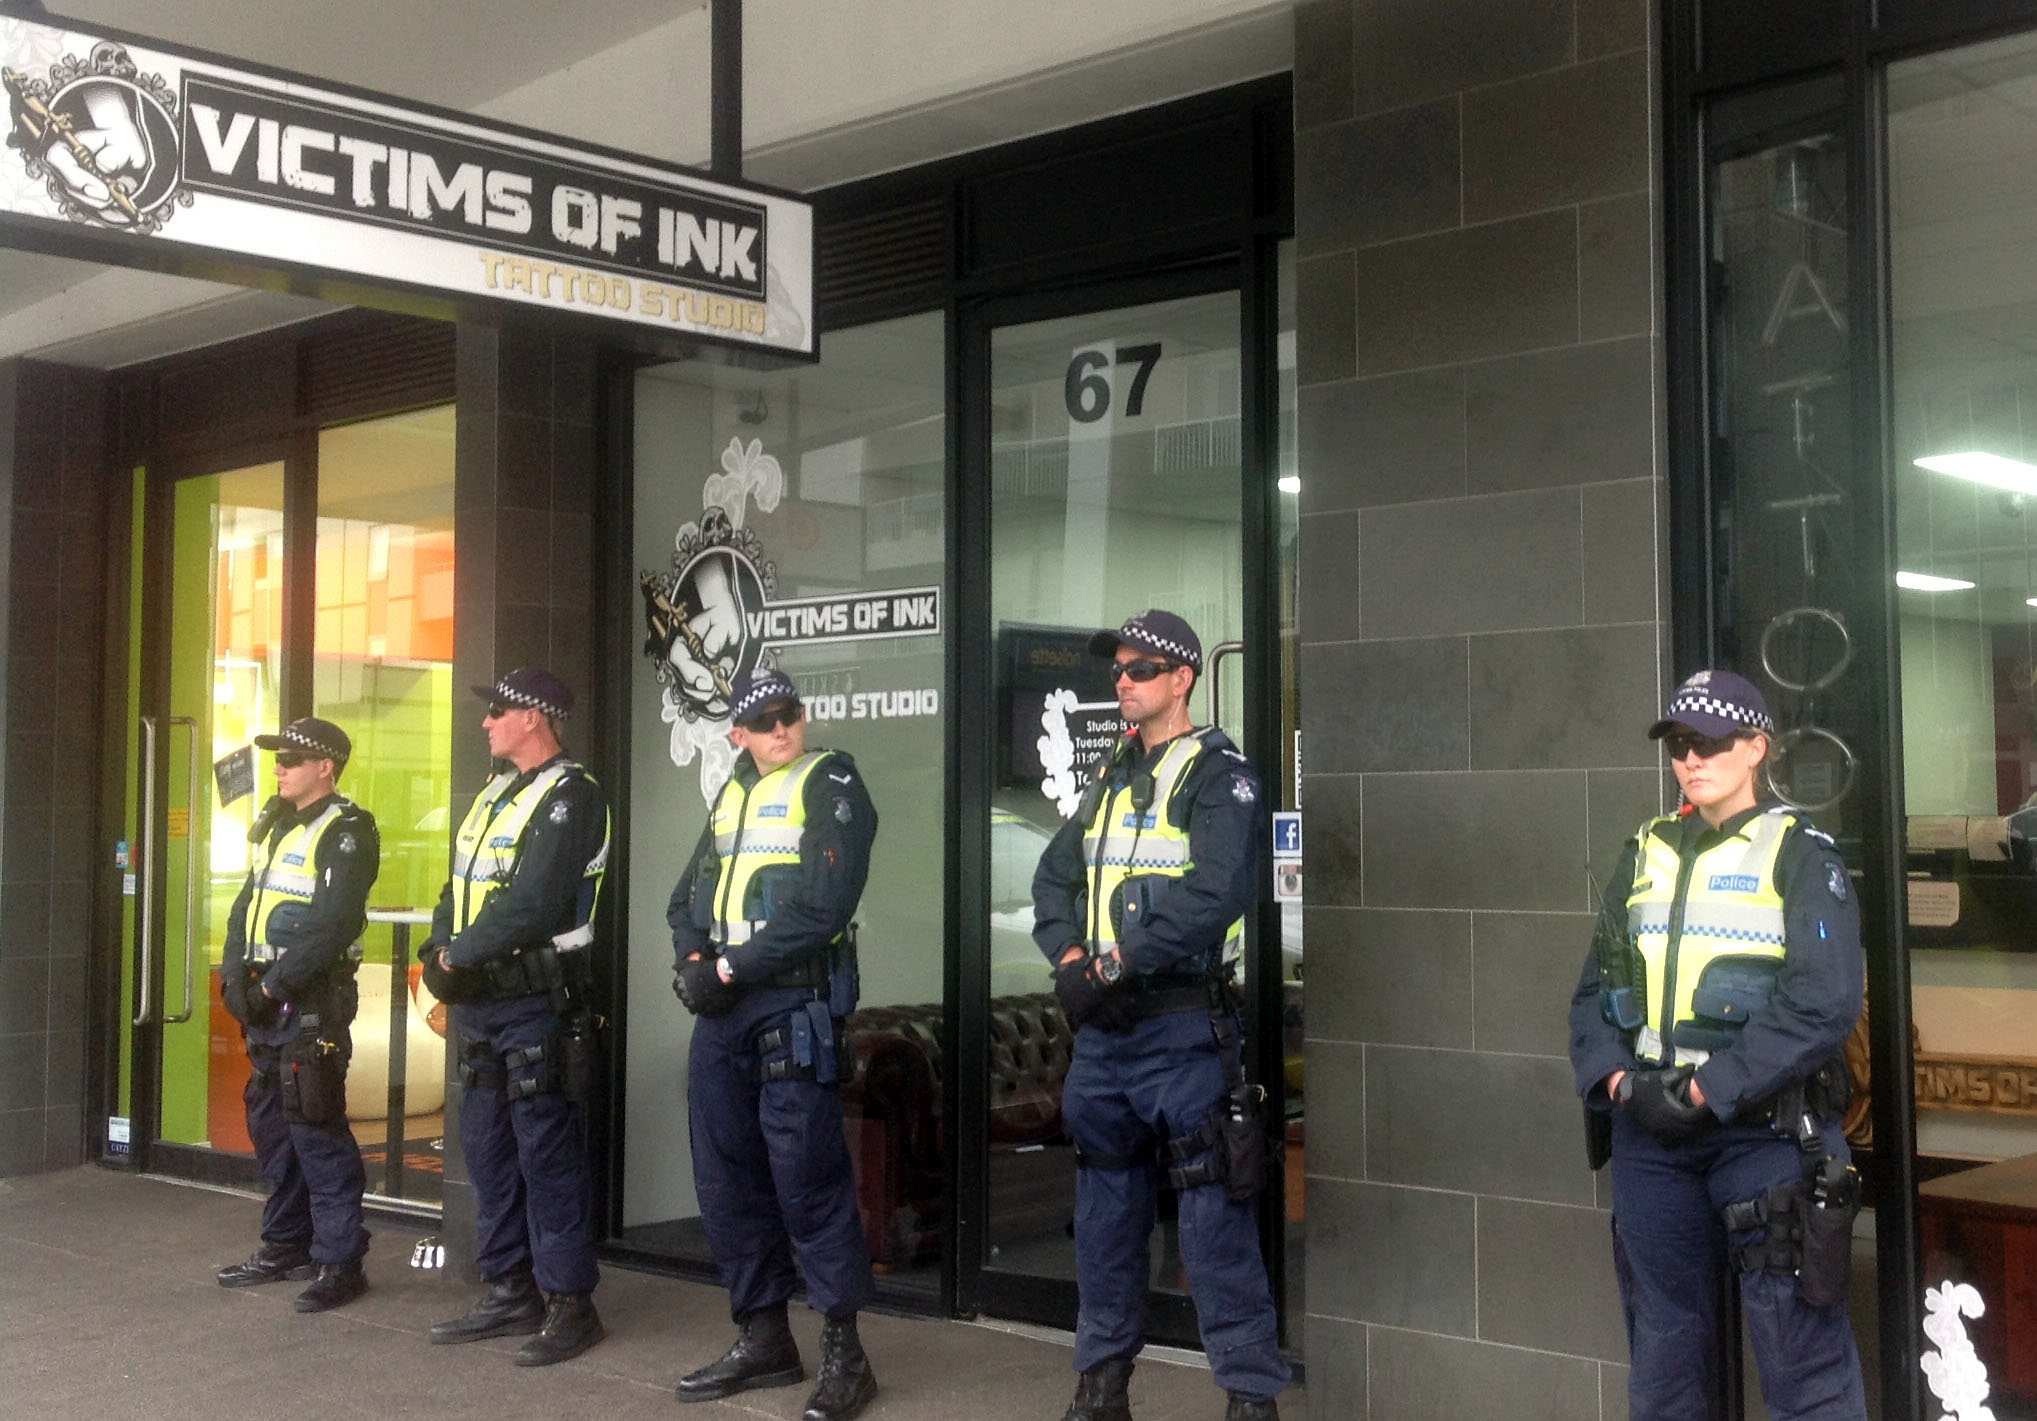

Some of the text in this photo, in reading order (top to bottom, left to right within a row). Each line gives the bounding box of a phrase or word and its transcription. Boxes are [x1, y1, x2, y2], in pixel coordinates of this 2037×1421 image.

[190, 102, 758, 282] VICTIMS OF INK
[479, 250, 766, 337] TATTOO STUDIO
[1065, 342, 1162, 423] 67
[747, 595, 935, 639] VICTIMS OF INK
[800, 688, 938, 724] TOO STUDIO
[1086, 719, 1118, 733] Studio
[1710, 875, 1757, 890] Police
